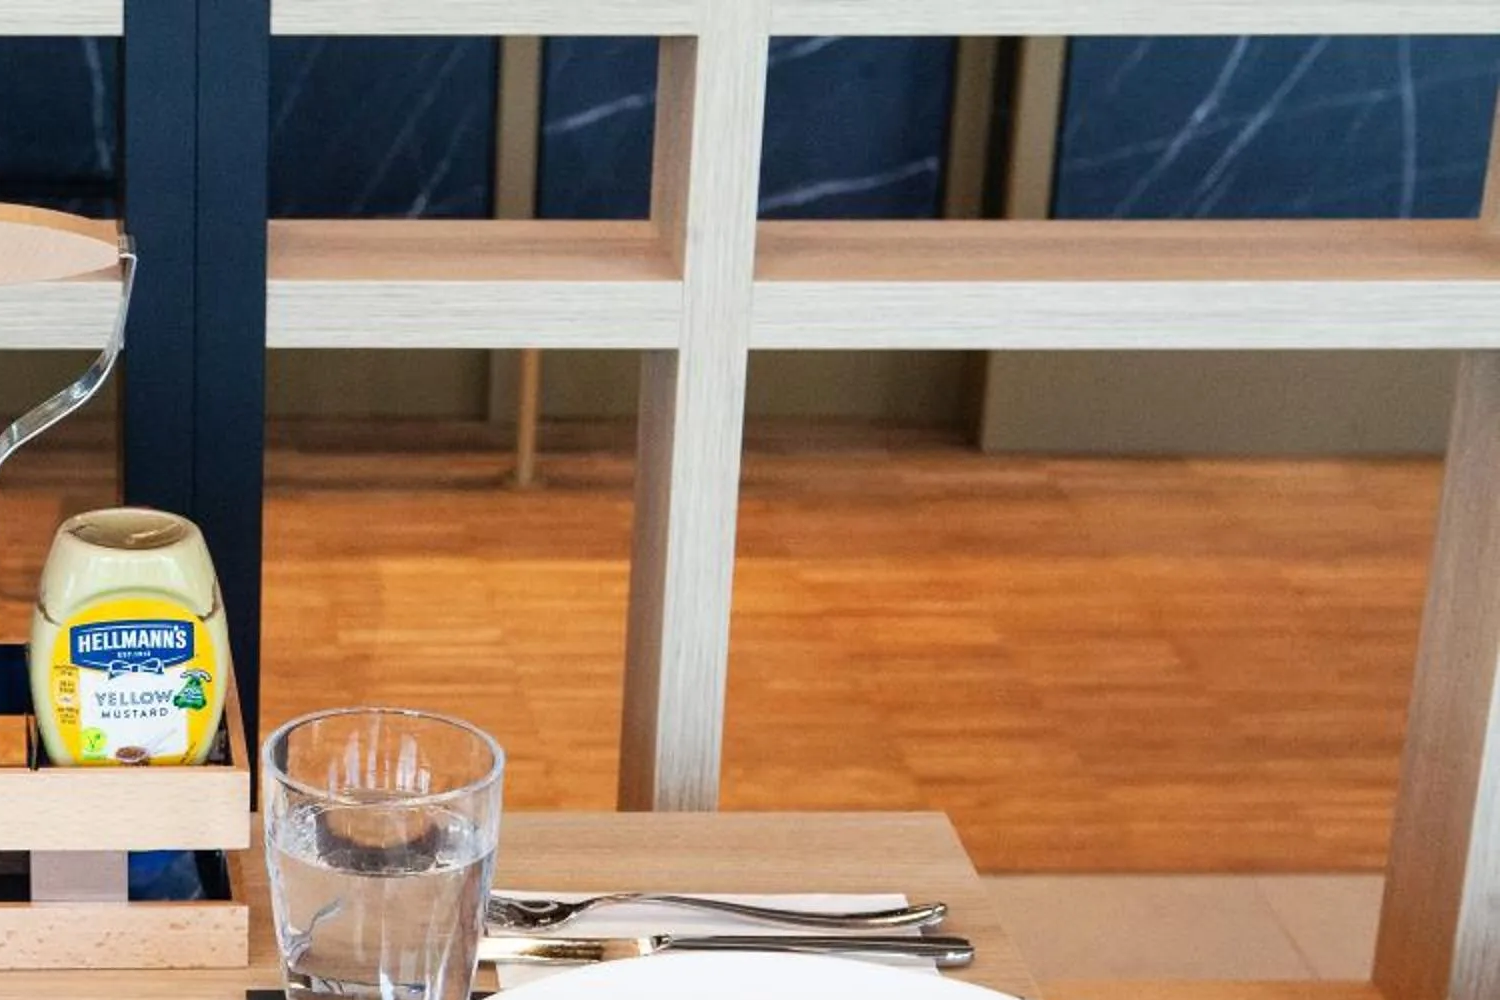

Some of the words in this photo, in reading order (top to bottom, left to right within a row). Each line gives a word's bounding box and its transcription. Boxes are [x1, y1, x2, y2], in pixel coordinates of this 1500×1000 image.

[78, 625, 187, 653] HELLMANN'S
[95, 689, 174, 706] YELLOW
[101, 707, 169, 719] MUSTARD
